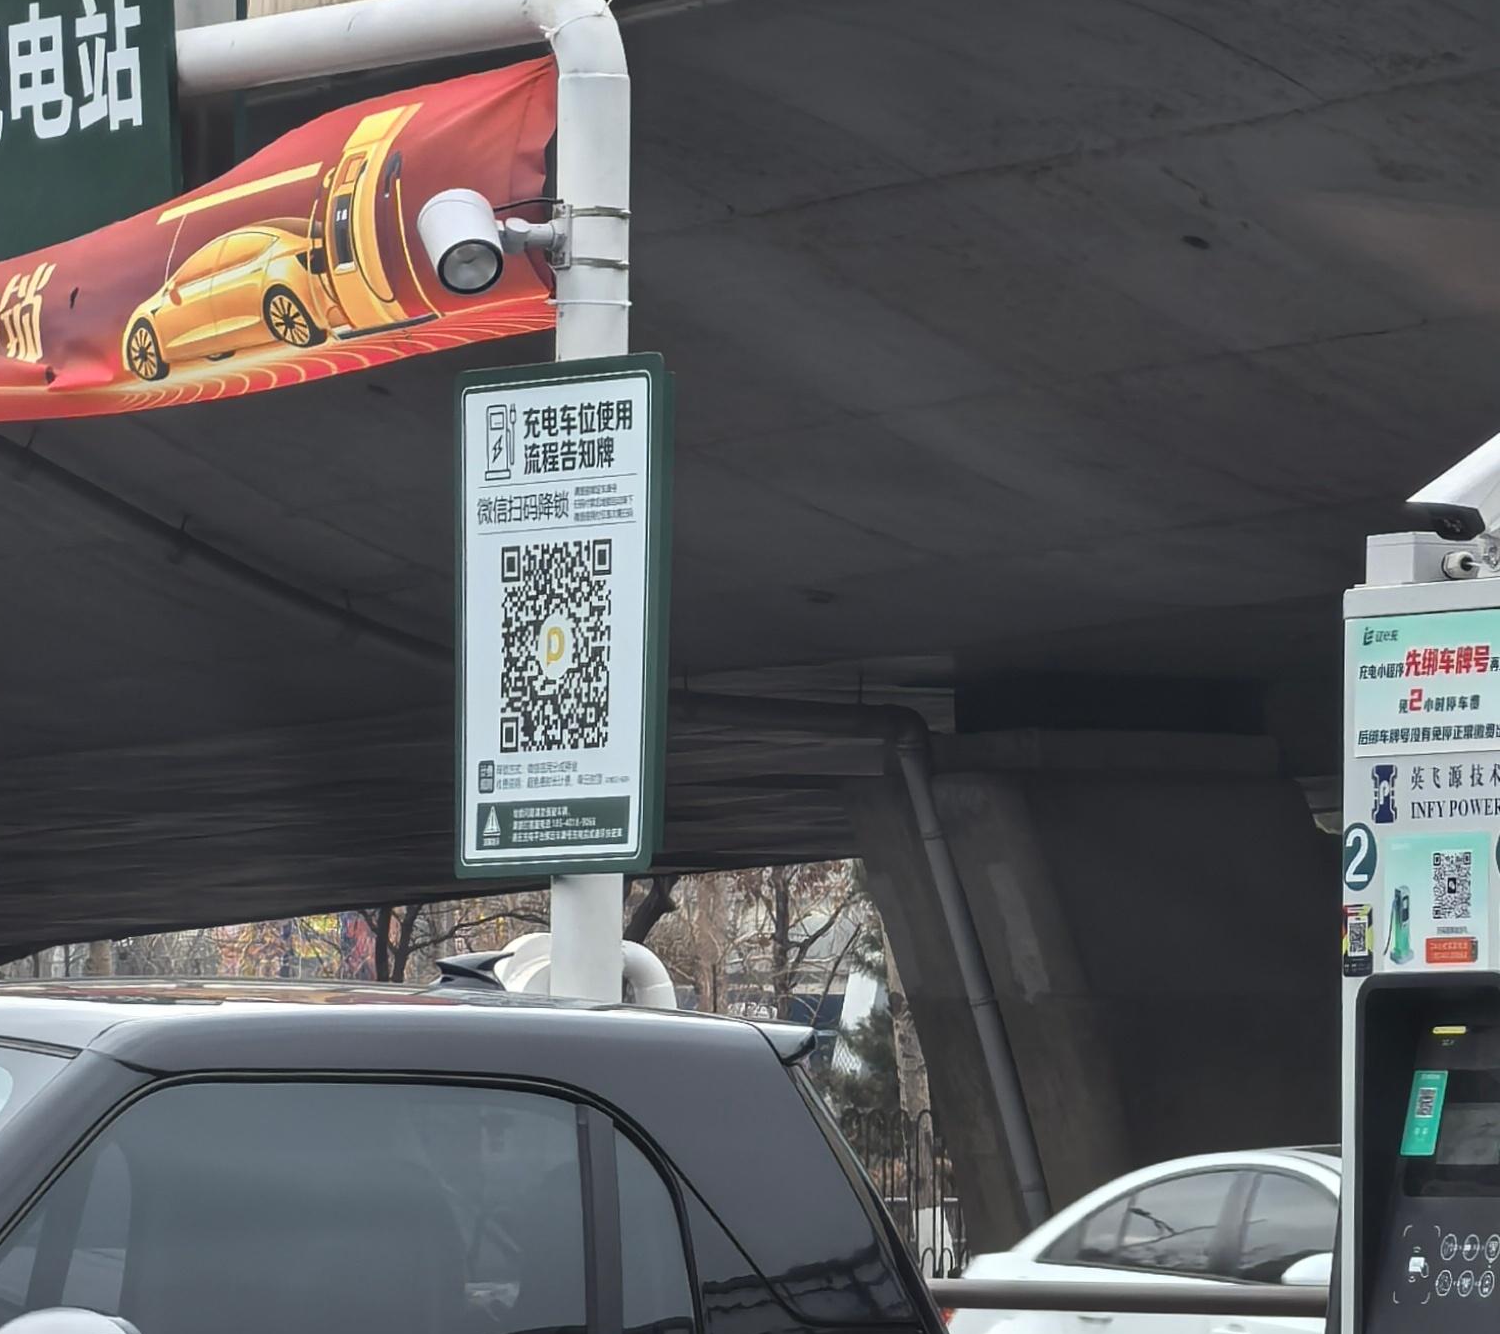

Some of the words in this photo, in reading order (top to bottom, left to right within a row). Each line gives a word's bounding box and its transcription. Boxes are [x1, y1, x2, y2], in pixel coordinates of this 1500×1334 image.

[523, 399, 633, 439] 充电车位使用
[524, 436, 615, 475] 流程告知牌
[477, 491, 569, 525] 微信扫码降锁
[1345, 827, 1368, 882] 2
